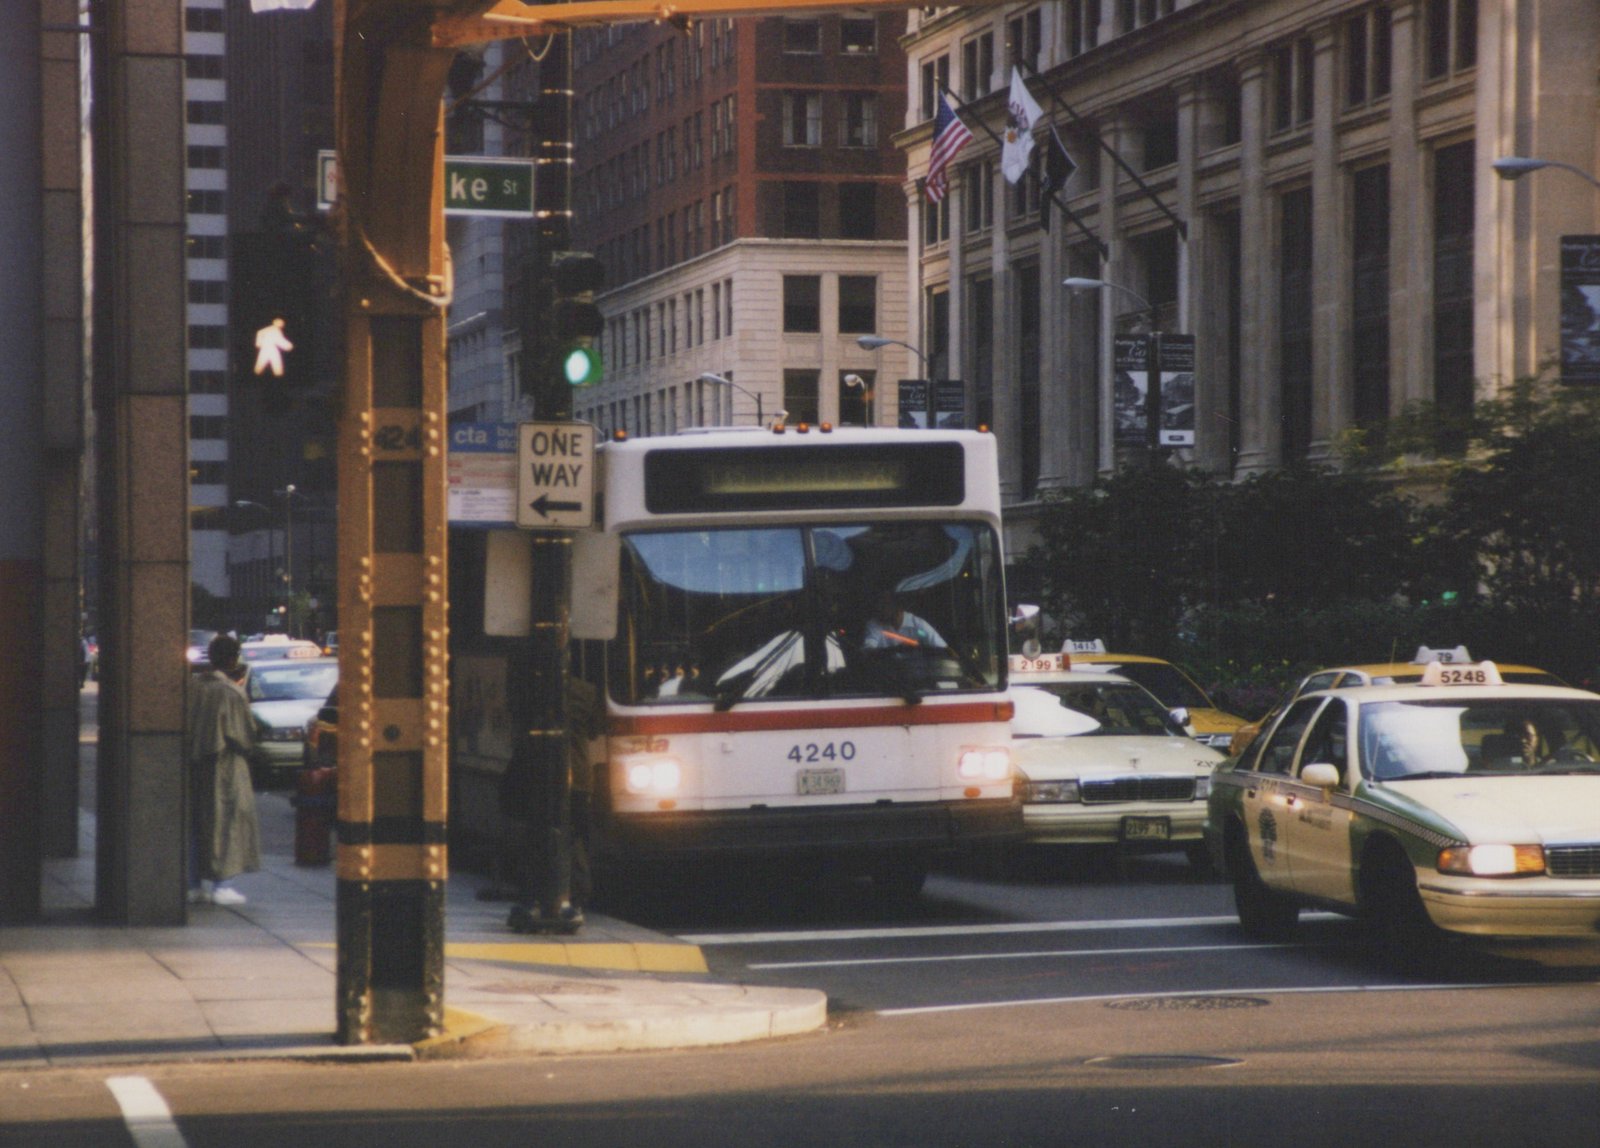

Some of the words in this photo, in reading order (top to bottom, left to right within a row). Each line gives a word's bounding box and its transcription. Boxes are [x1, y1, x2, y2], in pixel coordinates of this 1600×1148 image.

[450, 171, 489, 202] ke
[502, 179, 518, 196] St
[454, 426, 488, 445] cta
[531, 431, 583, 457] ONE
[531, 462, 583, 487] WAY
[1072, 641, 1097, 651] 1413
[1440, 670, 1486, 683] 5248
[787, 740, 856, 764] 4240
